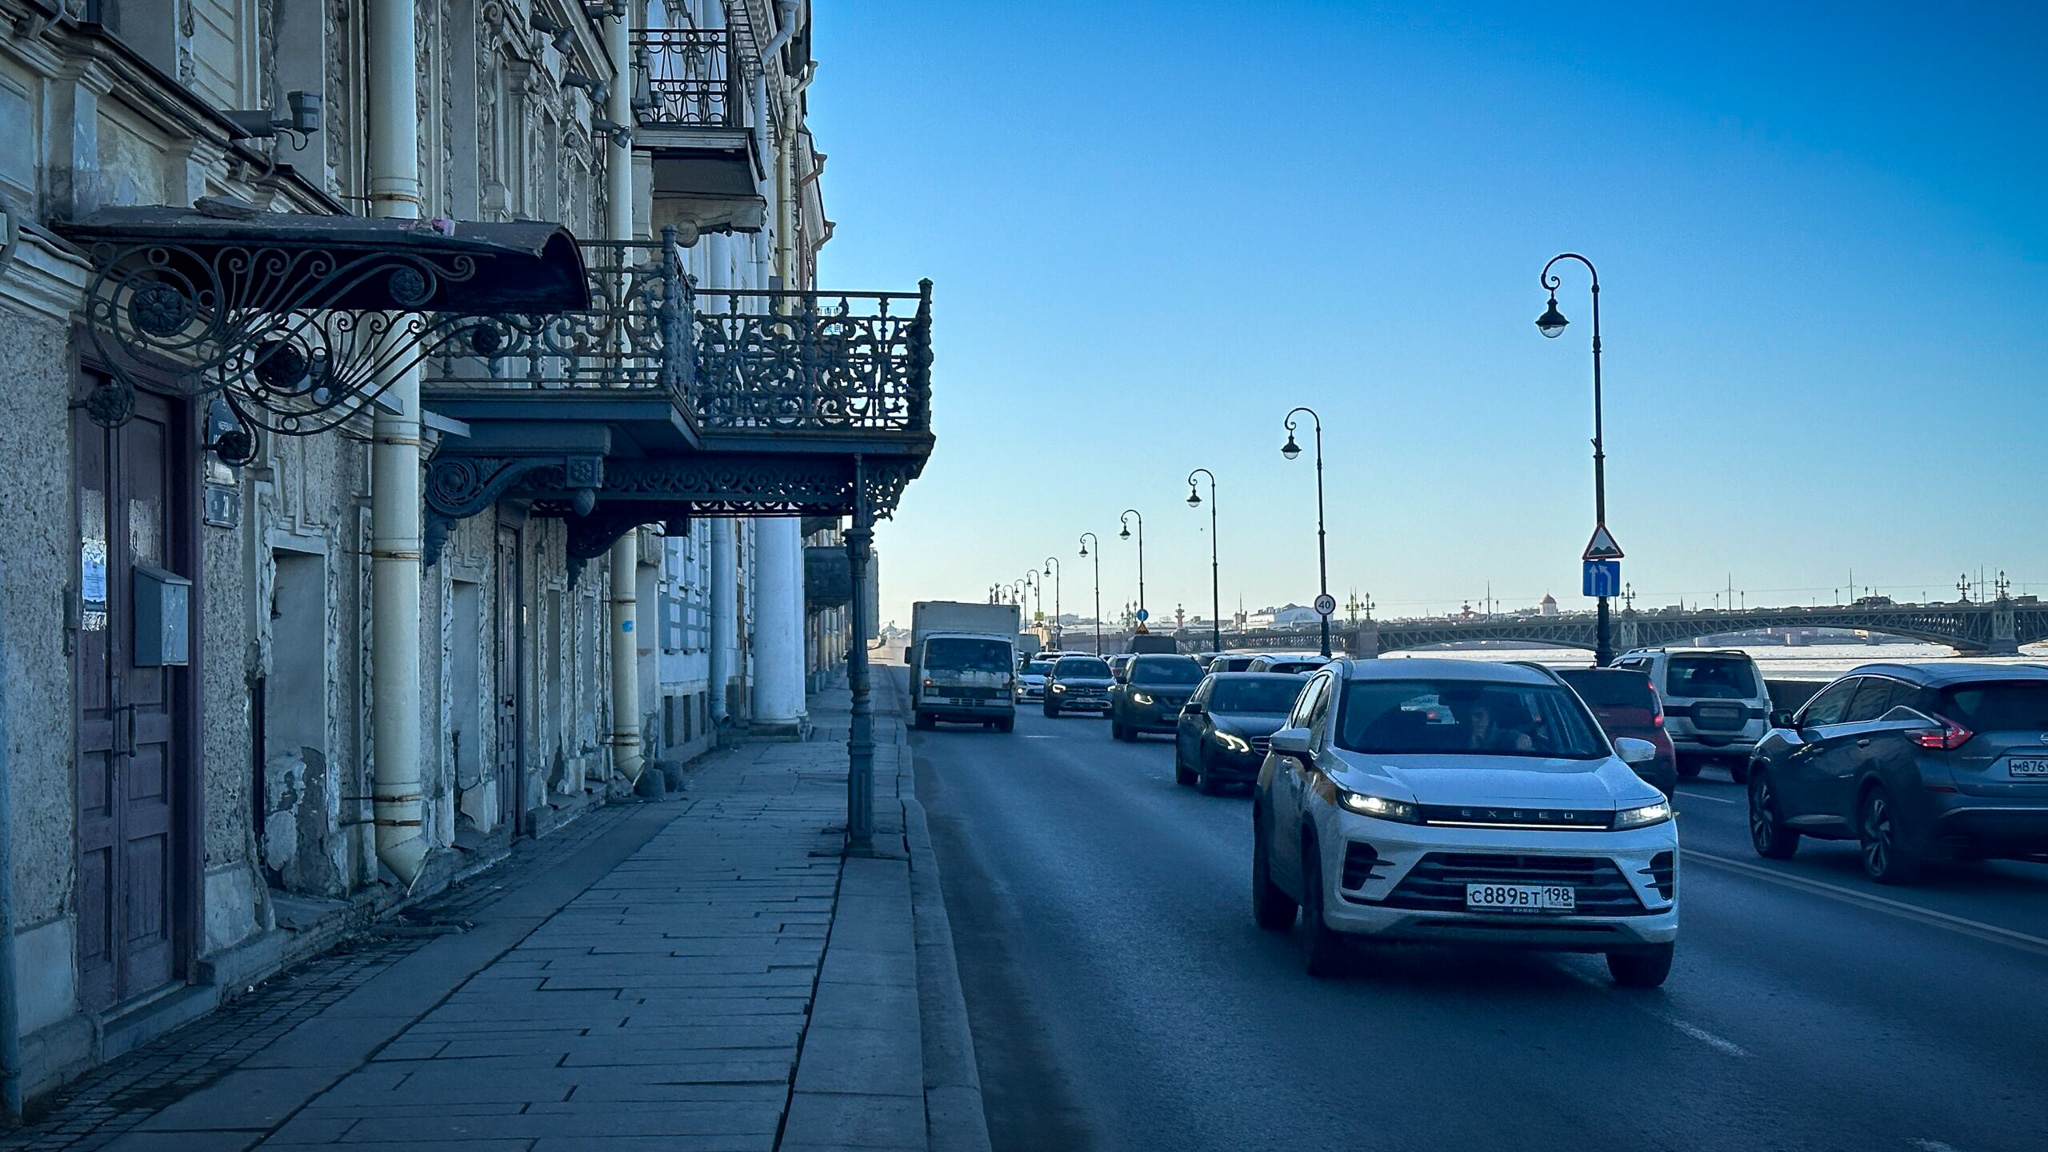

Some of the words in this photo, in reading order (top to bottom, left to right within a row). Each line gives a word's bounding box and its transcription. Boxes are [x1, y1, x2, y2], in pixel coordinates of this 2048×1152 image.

[1318, 600, 1331, 609] 40
[2013, 760, 2048, 773] М876
[1544, 887, 1570, 902] 198
